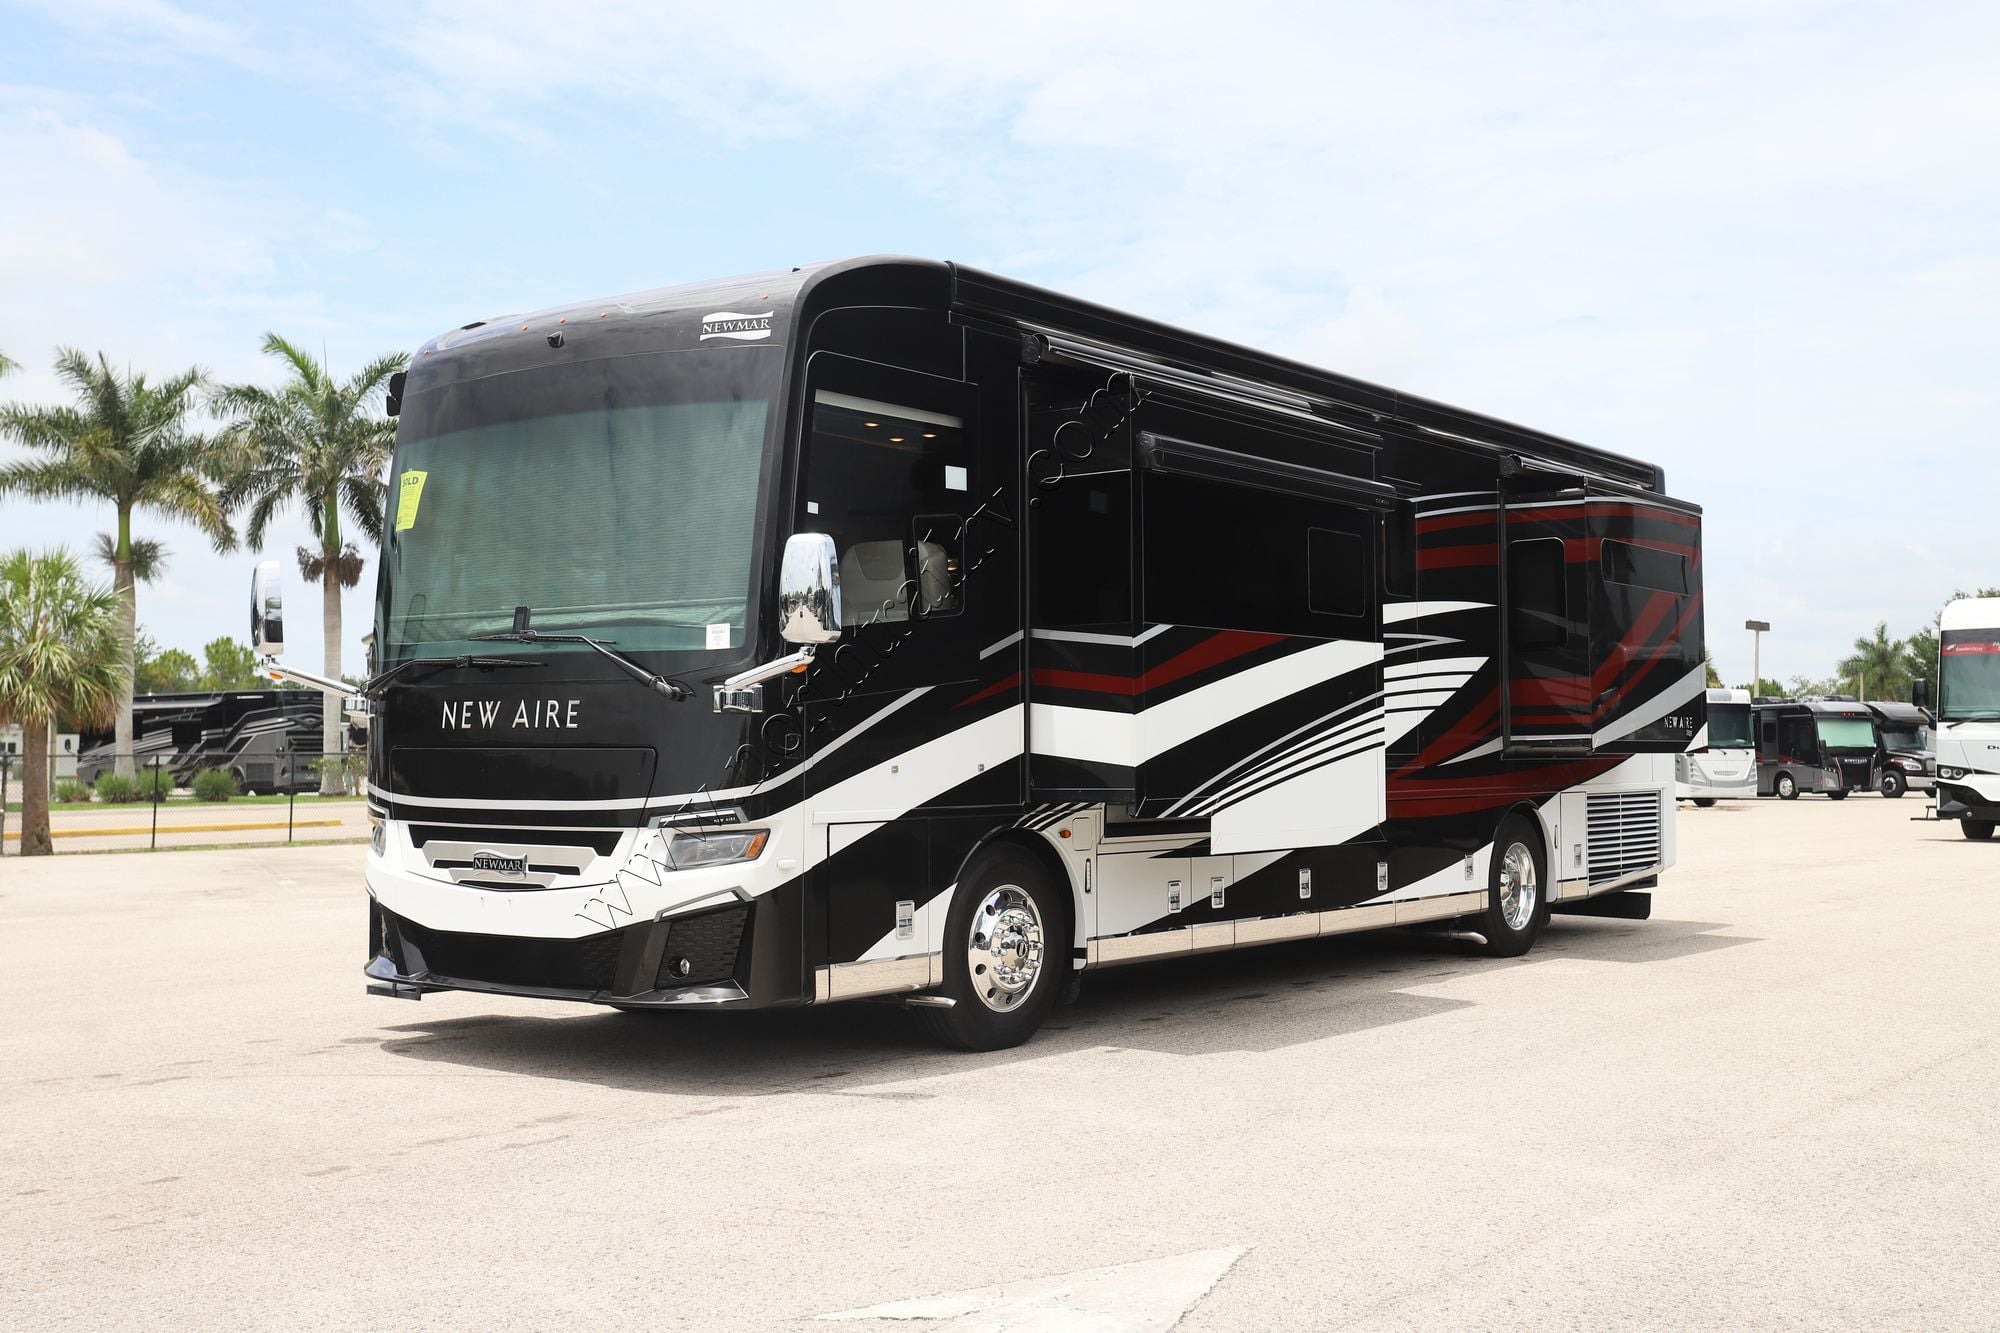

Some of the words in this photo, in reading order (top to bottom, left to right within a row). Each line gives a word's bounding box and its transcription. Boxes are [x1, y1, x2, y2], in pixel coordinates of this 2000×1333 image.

[702, 318, 771, 334] NEWMAR
[441, 700, 501, 730] NEW
[511, 699, 581, 729] AIRE
[1664, 716, 1678, 728] NEW
[1679, 716, 1693, 729] AIRE
[474, 858, 522, 871] NEWMAR
